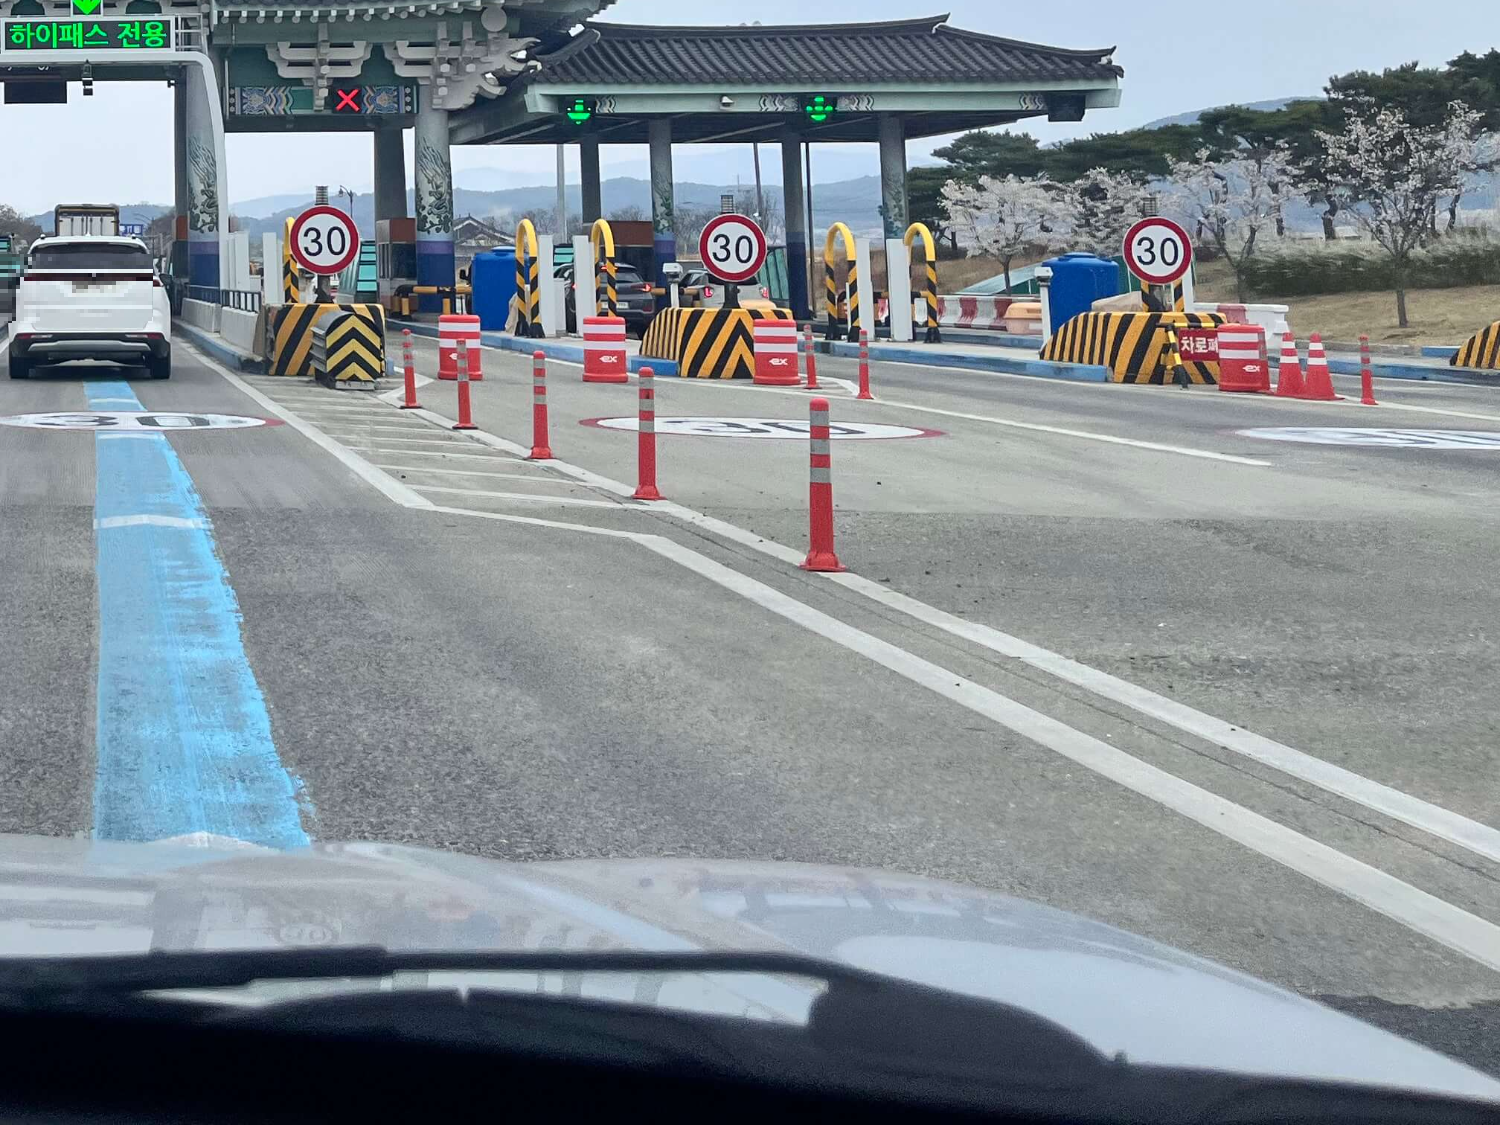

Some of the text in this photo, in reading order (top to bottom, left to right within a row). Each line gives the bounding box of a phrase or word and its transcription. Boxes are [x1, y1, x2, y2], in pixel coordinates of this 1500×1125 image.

[9, 21, 168, 49] 하이패스 전용
[303, 226, 346, 256] 30
[712, 233, 753, 263] 30
[1137, 236, 1179, 266] 30
[34, 415, 211, 428] 30
